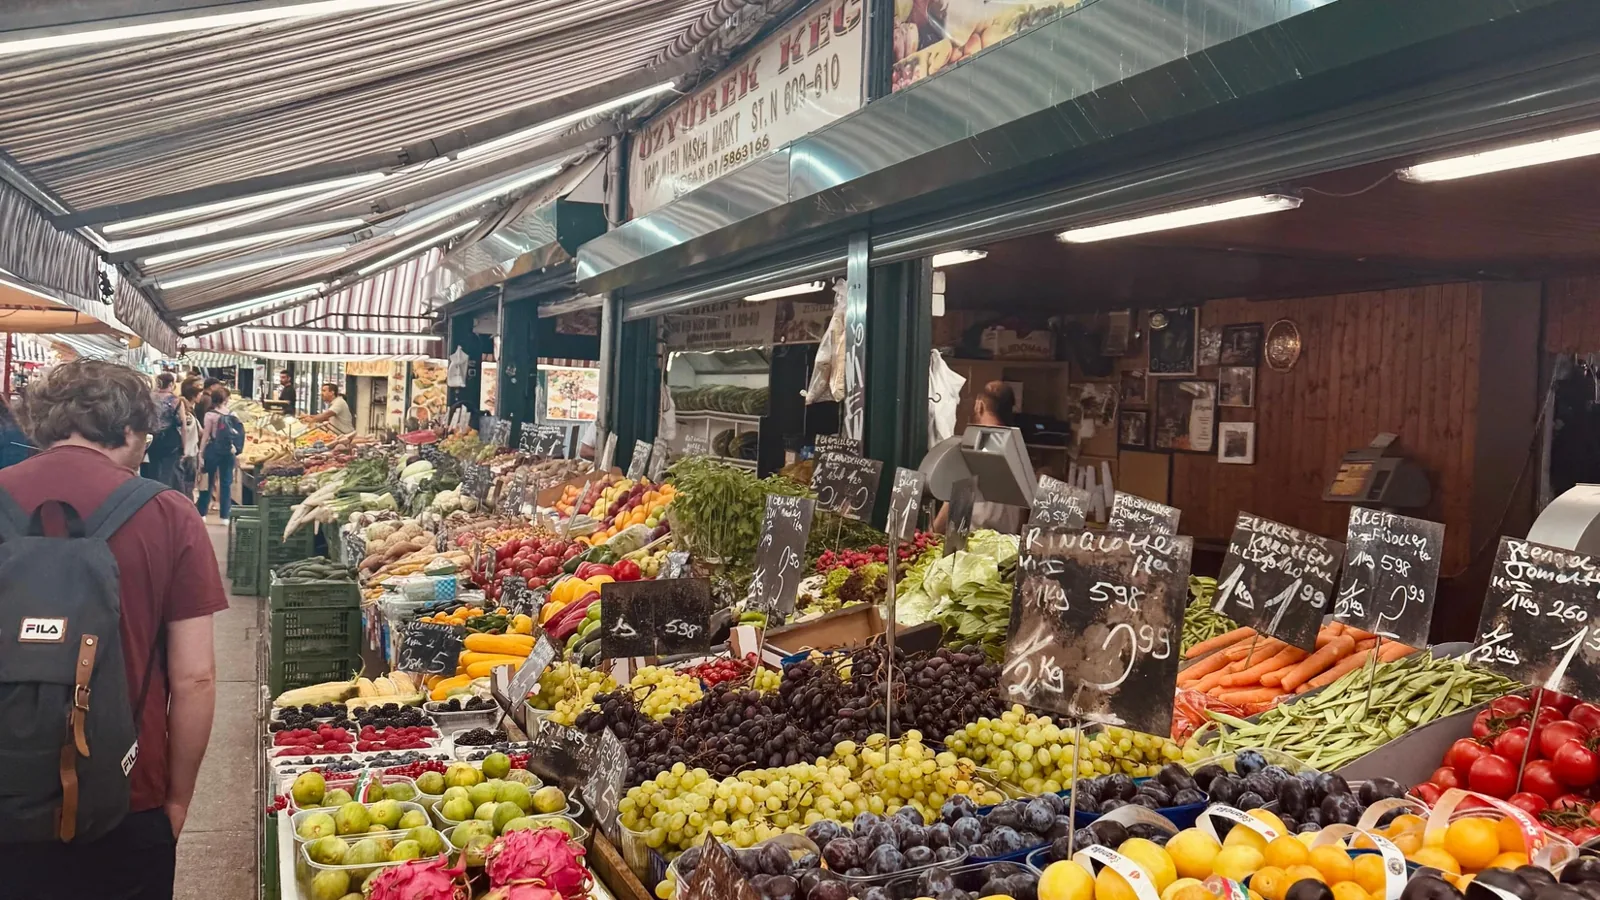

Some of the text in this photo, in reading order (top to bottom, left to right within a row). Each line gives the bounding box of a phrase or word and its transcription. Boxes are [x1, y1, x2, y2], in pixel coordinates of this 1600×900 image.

[784, 53, 840, 115] 609-610
[1236, 516, 1302, 543] ZUCKER
[26, 624, 58, 634] FILA
[427, 651, 449, 673] 5
